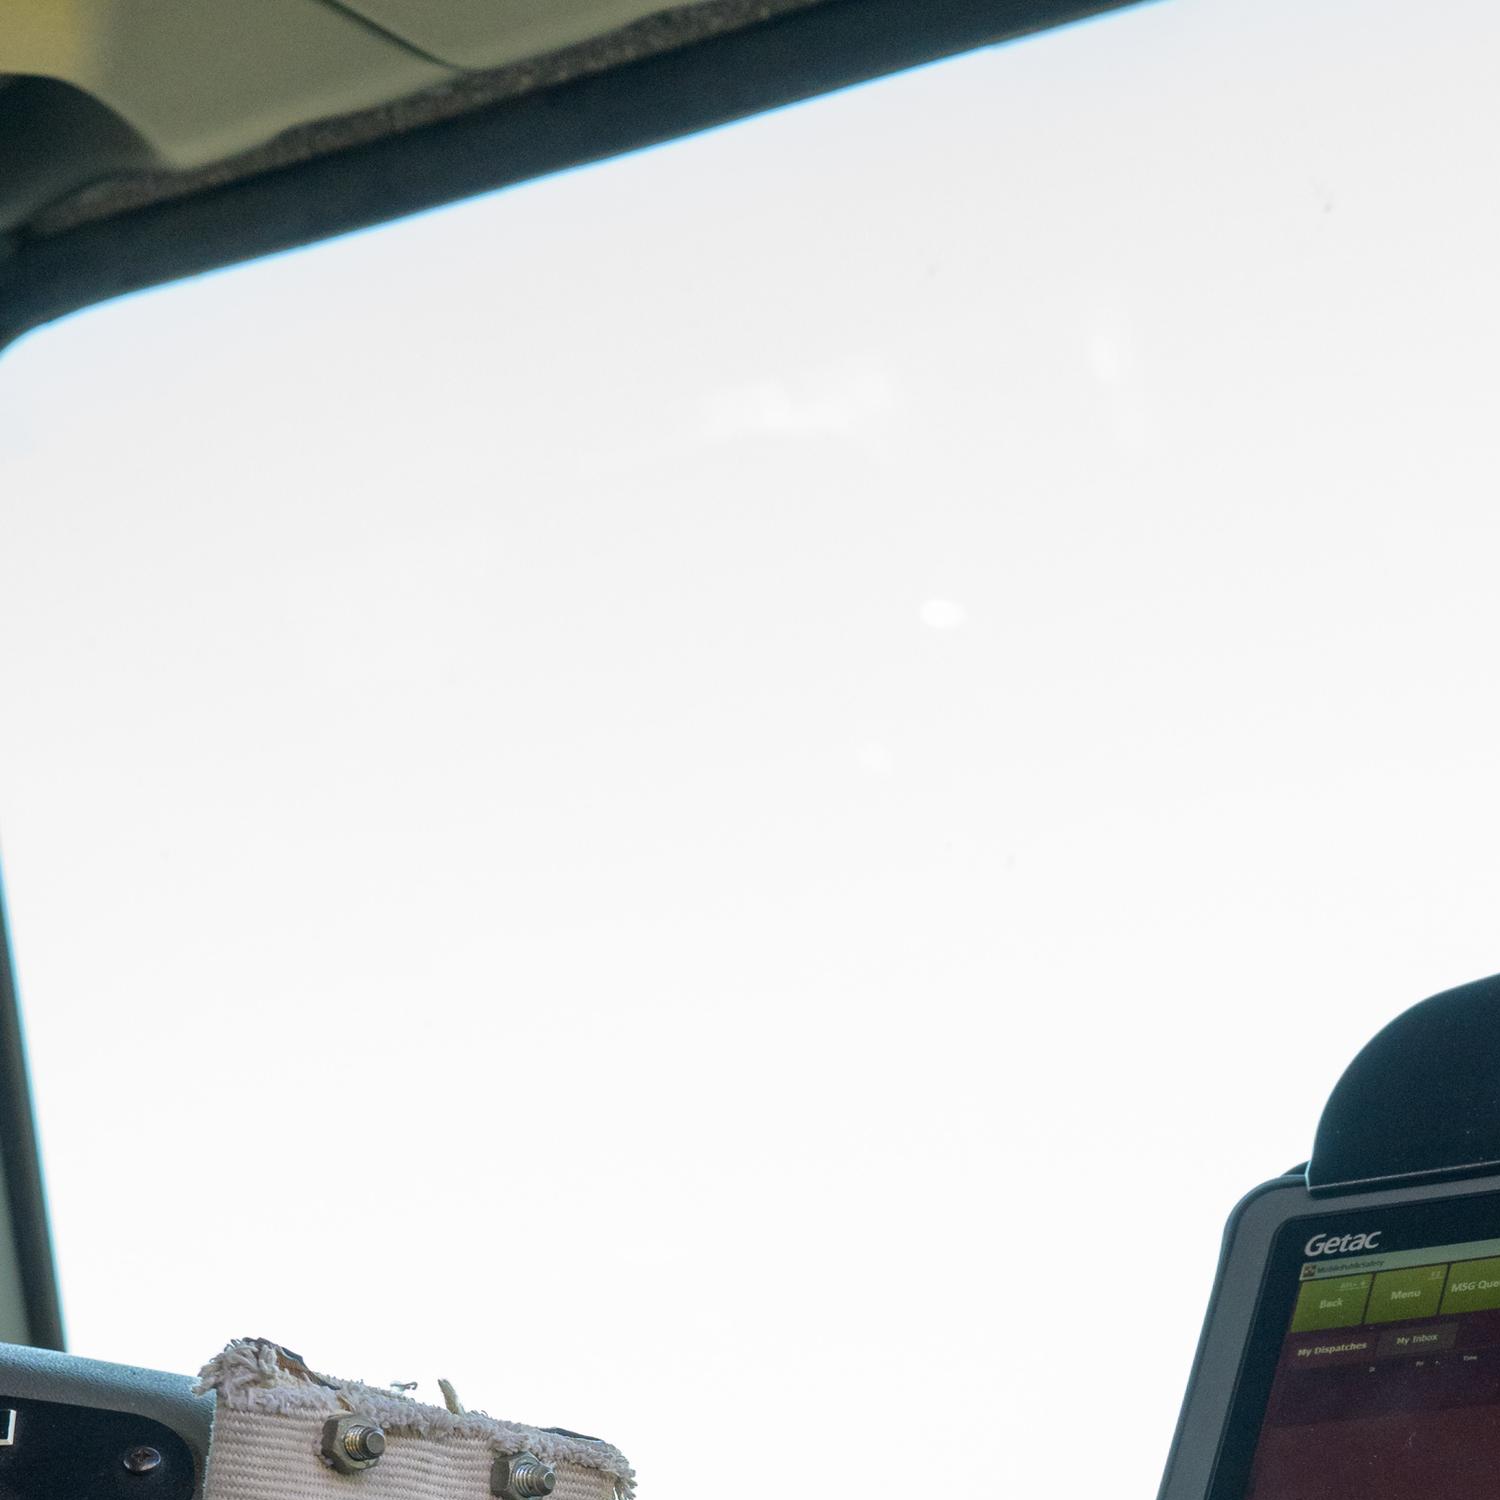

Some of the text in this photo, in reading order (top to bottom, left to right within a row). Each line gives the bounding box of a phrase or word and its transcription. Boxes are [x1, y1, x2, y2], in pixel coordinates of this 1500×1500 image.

[1304, 1231, 1383, 1257] Getac
[1451, 1281, 1476, 1293] MSG
[1391, 1289, 1422, 1301] Menu
[1319, 1297, 1344, 1310] Back
[1396, 1333, 1439, 1346] My Inbox
[1297, 1342, 1368, 1358] My Dispatches
